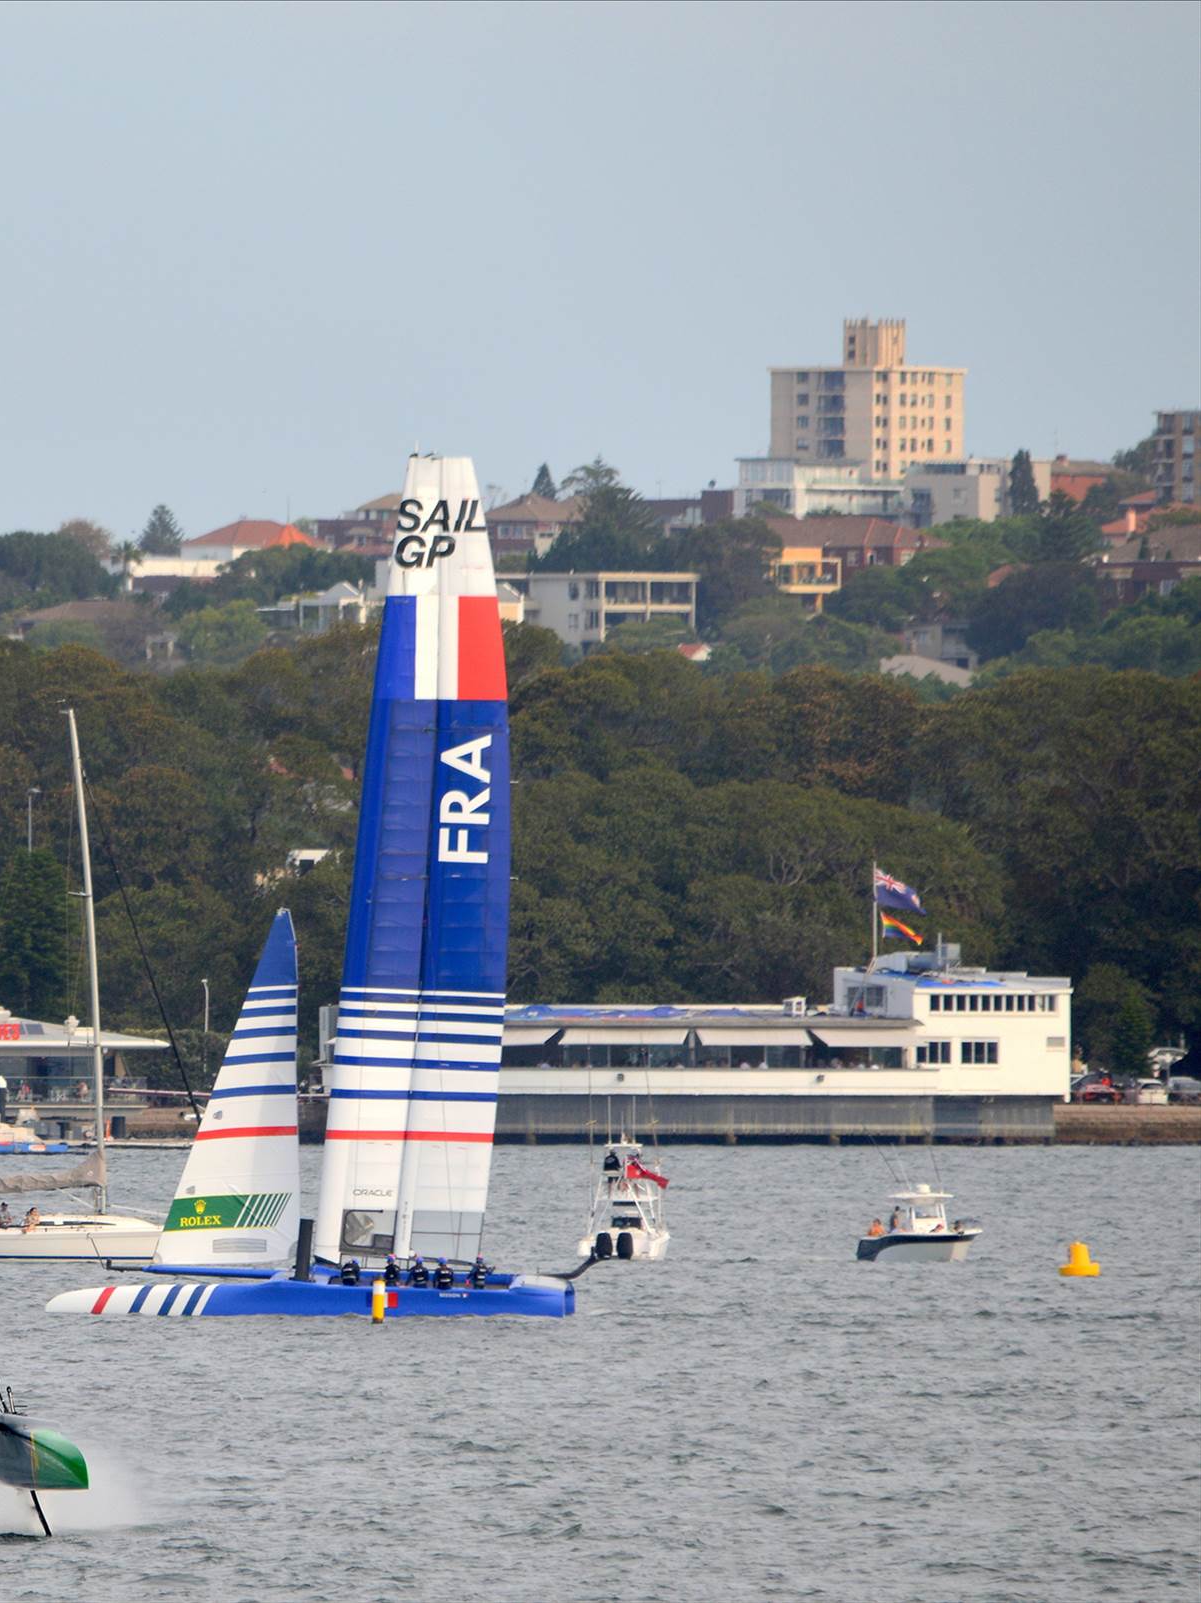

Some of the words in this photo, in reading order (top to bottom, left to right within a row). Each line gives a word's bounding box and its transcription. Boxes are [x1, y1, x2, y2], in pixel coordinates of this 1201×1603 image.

[397, 498, 486, 532] SAIL
[395, 535, 456, 568] GP
[438, 734, 492, 864] FRA
[352, 1188, 394, 1197] ORACLE
[180, 1215, 222, 1228] ROLEX
